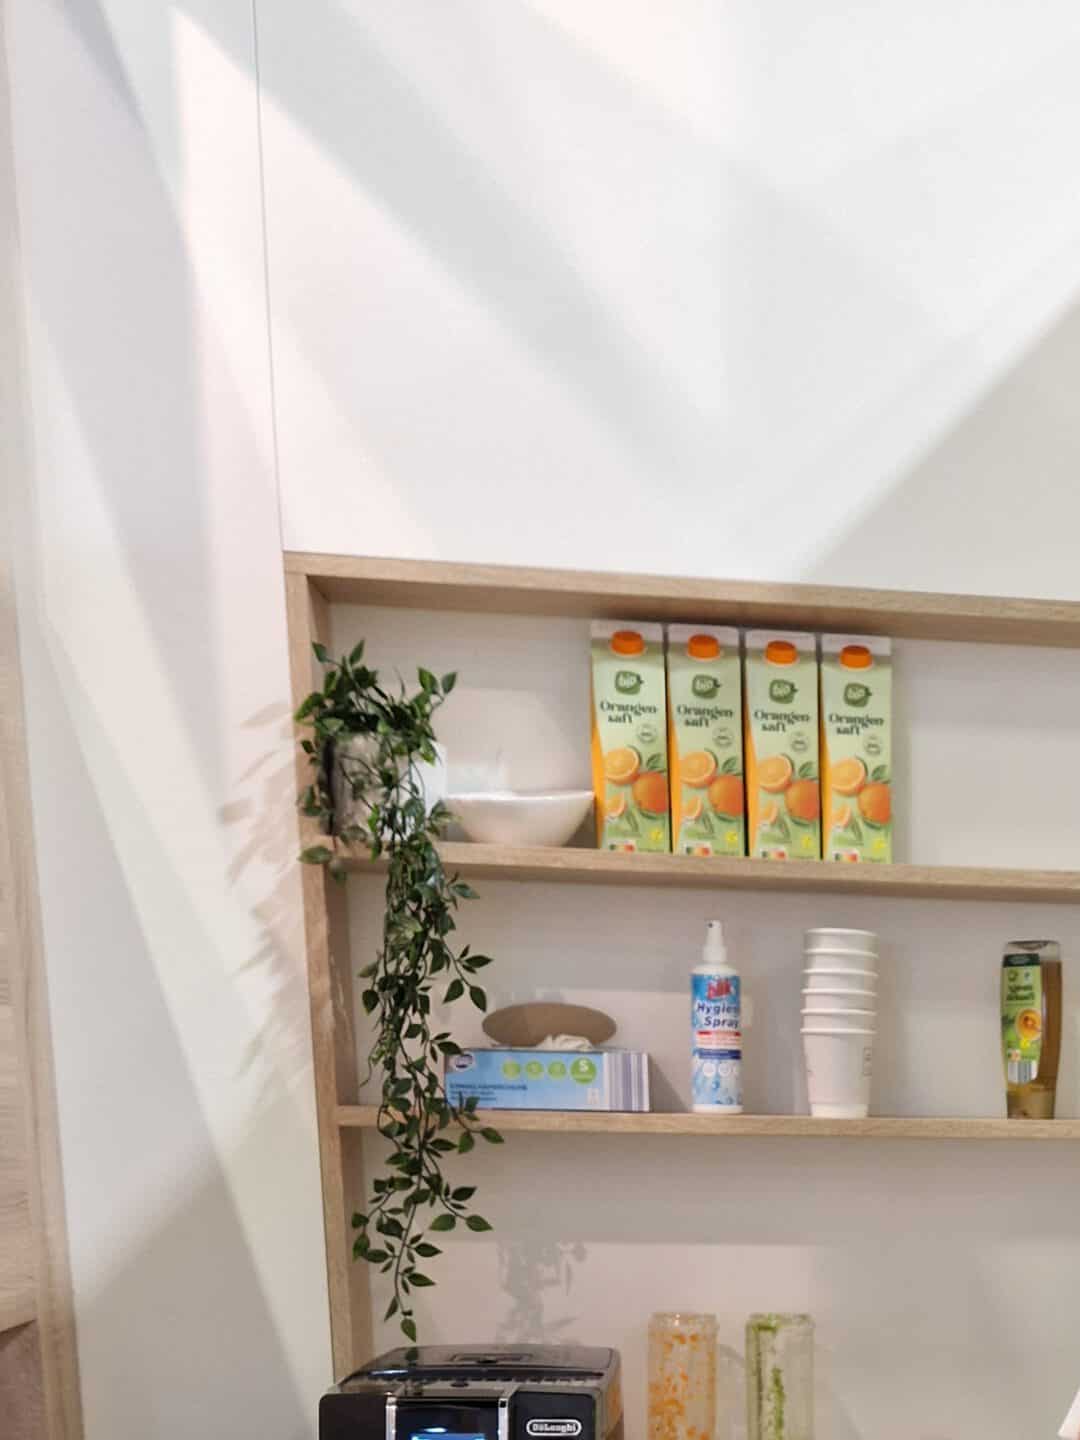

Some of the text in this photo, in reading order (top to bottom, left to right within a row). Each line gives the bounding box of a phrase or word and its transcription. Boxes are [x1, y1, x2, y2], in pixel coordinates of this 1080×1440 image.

[600, 700, 658, 717] Orangen
[676, 703, 733, 720] Orangen
[754, 708, 810, 725] Orangen
[828, 713, 885, 728] Orangen
[704, 1015, 739, 1029] Spray
